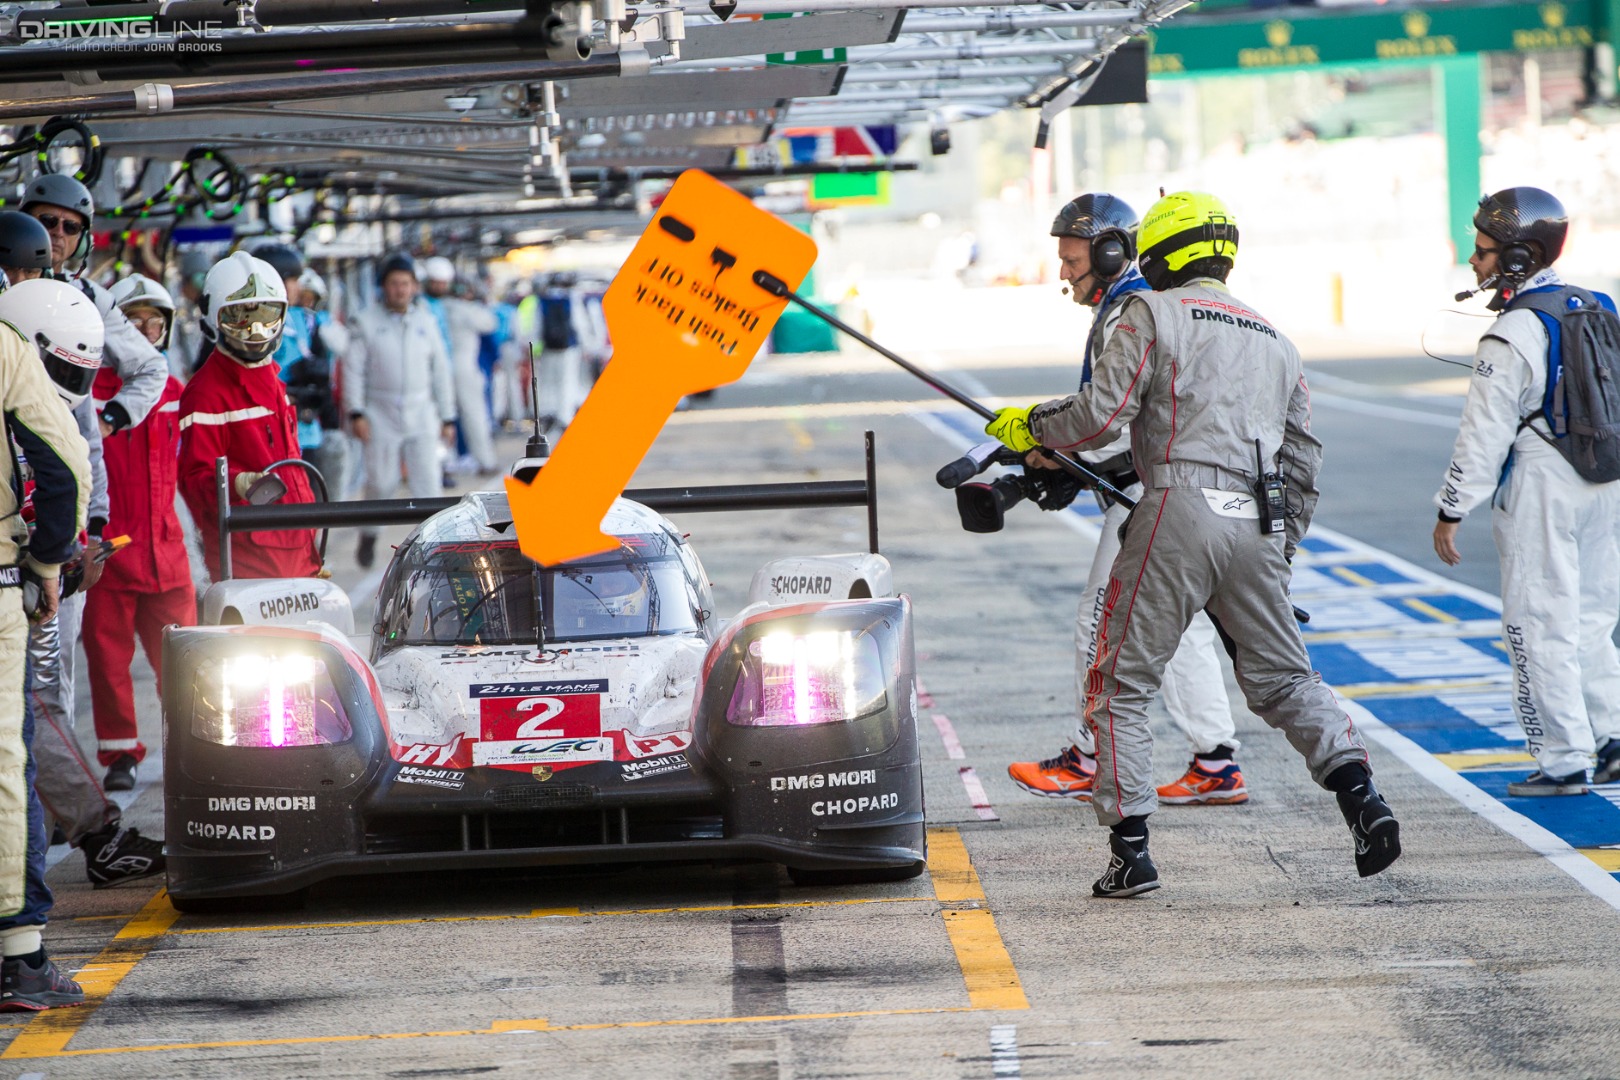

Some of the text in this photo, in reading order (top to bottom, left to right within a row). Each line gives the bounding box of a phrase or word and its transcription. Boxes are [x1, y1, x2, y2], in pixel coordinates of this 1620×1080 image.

[1512, 26, 1593, 48] ROLEX
[1238, 45, 1321, 68] ROLEX
[1376, 36, 1457, 58] ROLEX
[688, 281, 760, 333] Brakes
[632, 283, 739, 356] Push Back
[1191, 308, 1278, 340] DMG MORI
[776, 576, 832, 594] CHOPARD
[259, 592, 320, 619] CHOPARD
[441, 650, 532, 658] DMG
[545, 683, 600, 692] MANS
[1507, 625, 1544, 737] BROADCASTER
[516, 697, 565, 738] 2
[510, 739, 598, 754] WEC
[633, 735, 687, 753] P1
[399, 766, 447, 778] Mobil
[622, 757, 670, 772] Mobil
[643, 762, 688, 775] MICHELIN
[414, 778, 461, 788] MICHELIN
[771, 770, 876, 790] DMG MORI
[208, 796, 316, 811] DMG MORI
[811, 793, 898, 816] CHOPARD
[187, 821, 276, 840] CHOPARD
